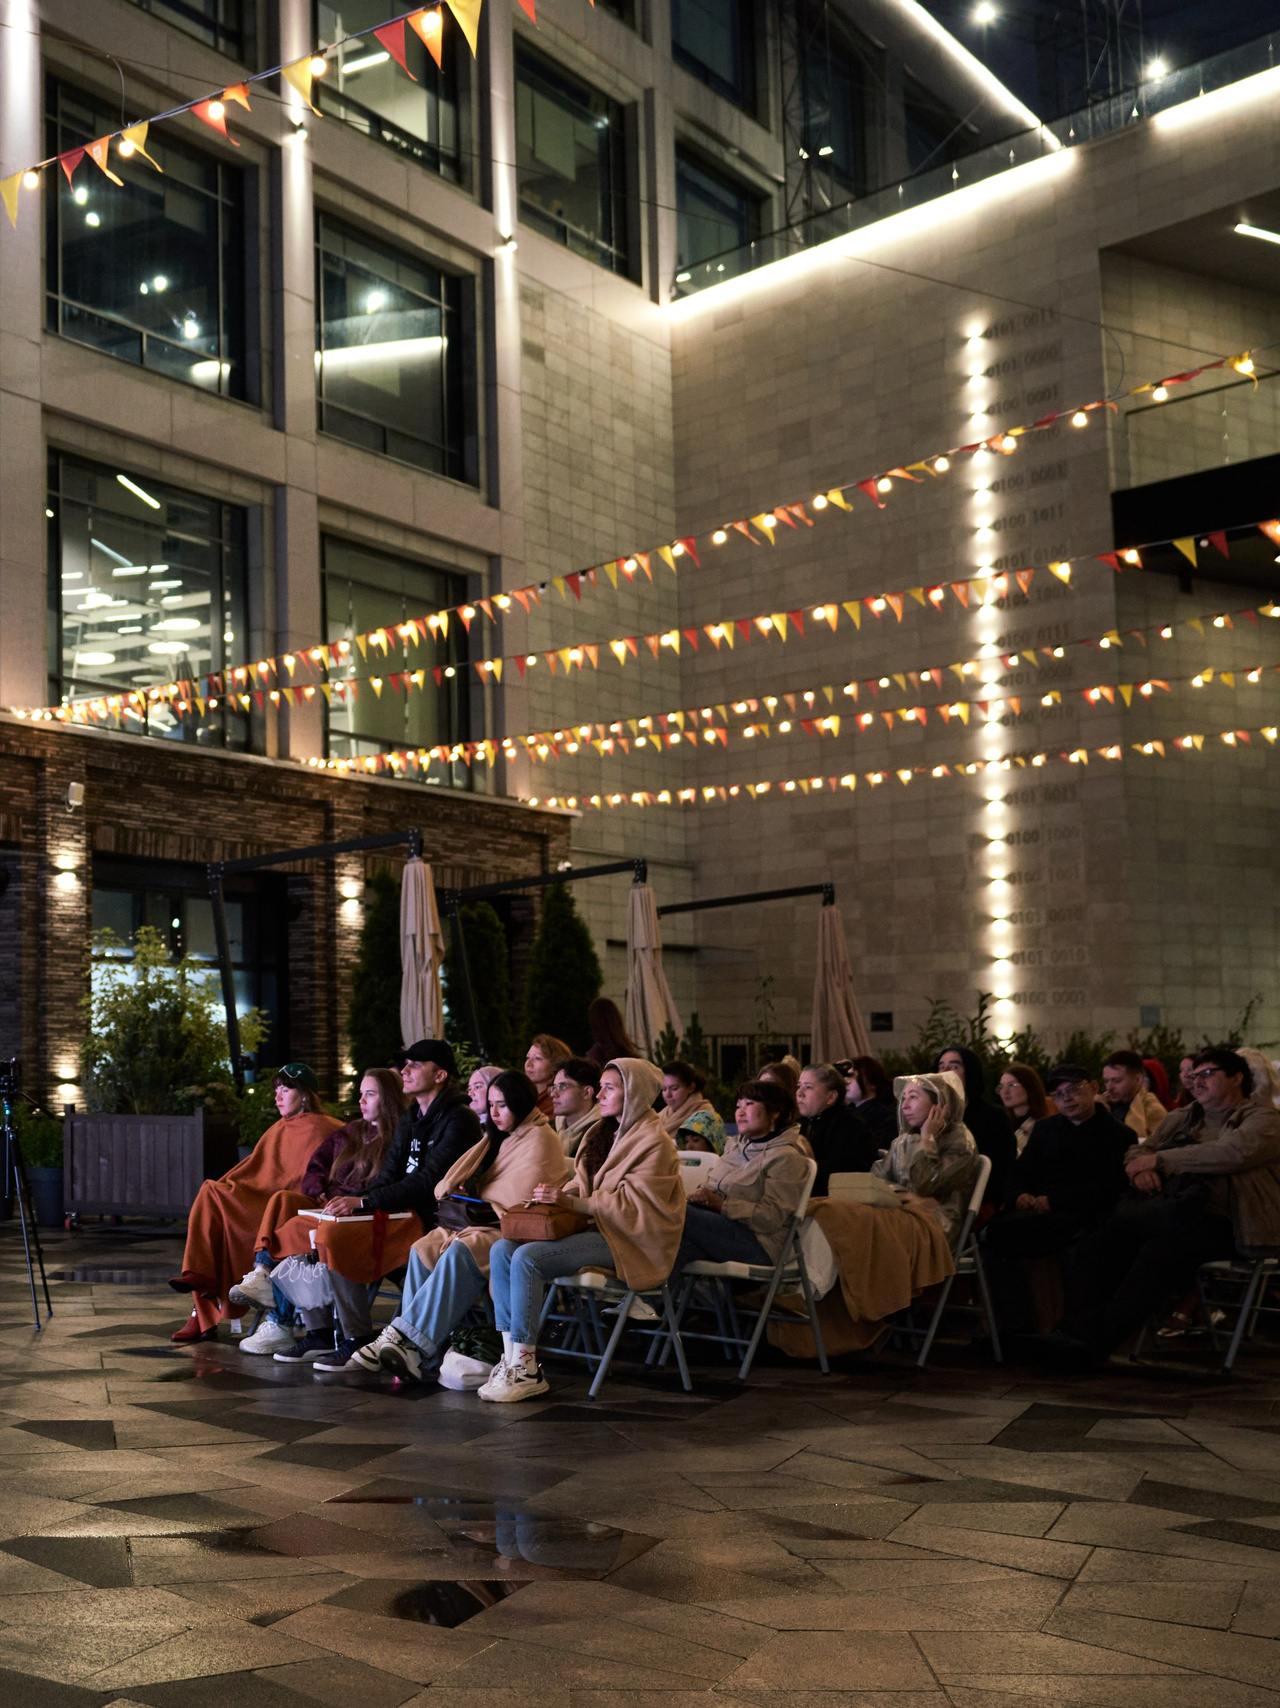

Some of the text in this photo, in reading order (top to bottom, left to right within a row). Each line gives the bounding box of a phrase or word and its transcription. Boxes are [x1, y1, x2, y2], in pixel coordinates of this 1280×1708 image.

[1023, 307, 1054, 327] 0011
[1026, 385, 1058, 406] 0001
[991, 475, 1024, 492] 0100
[992, 514, 1025, 531] 0100
[997, 632, 1029, 647] 0100
[1006, 829, 1040, 845] 0100
[1007, 870, 1041, 884] 0100
[1011, 948, 1085, 965] 0101 0010
[1013, 989, 1085, 1005] 0100 0001
